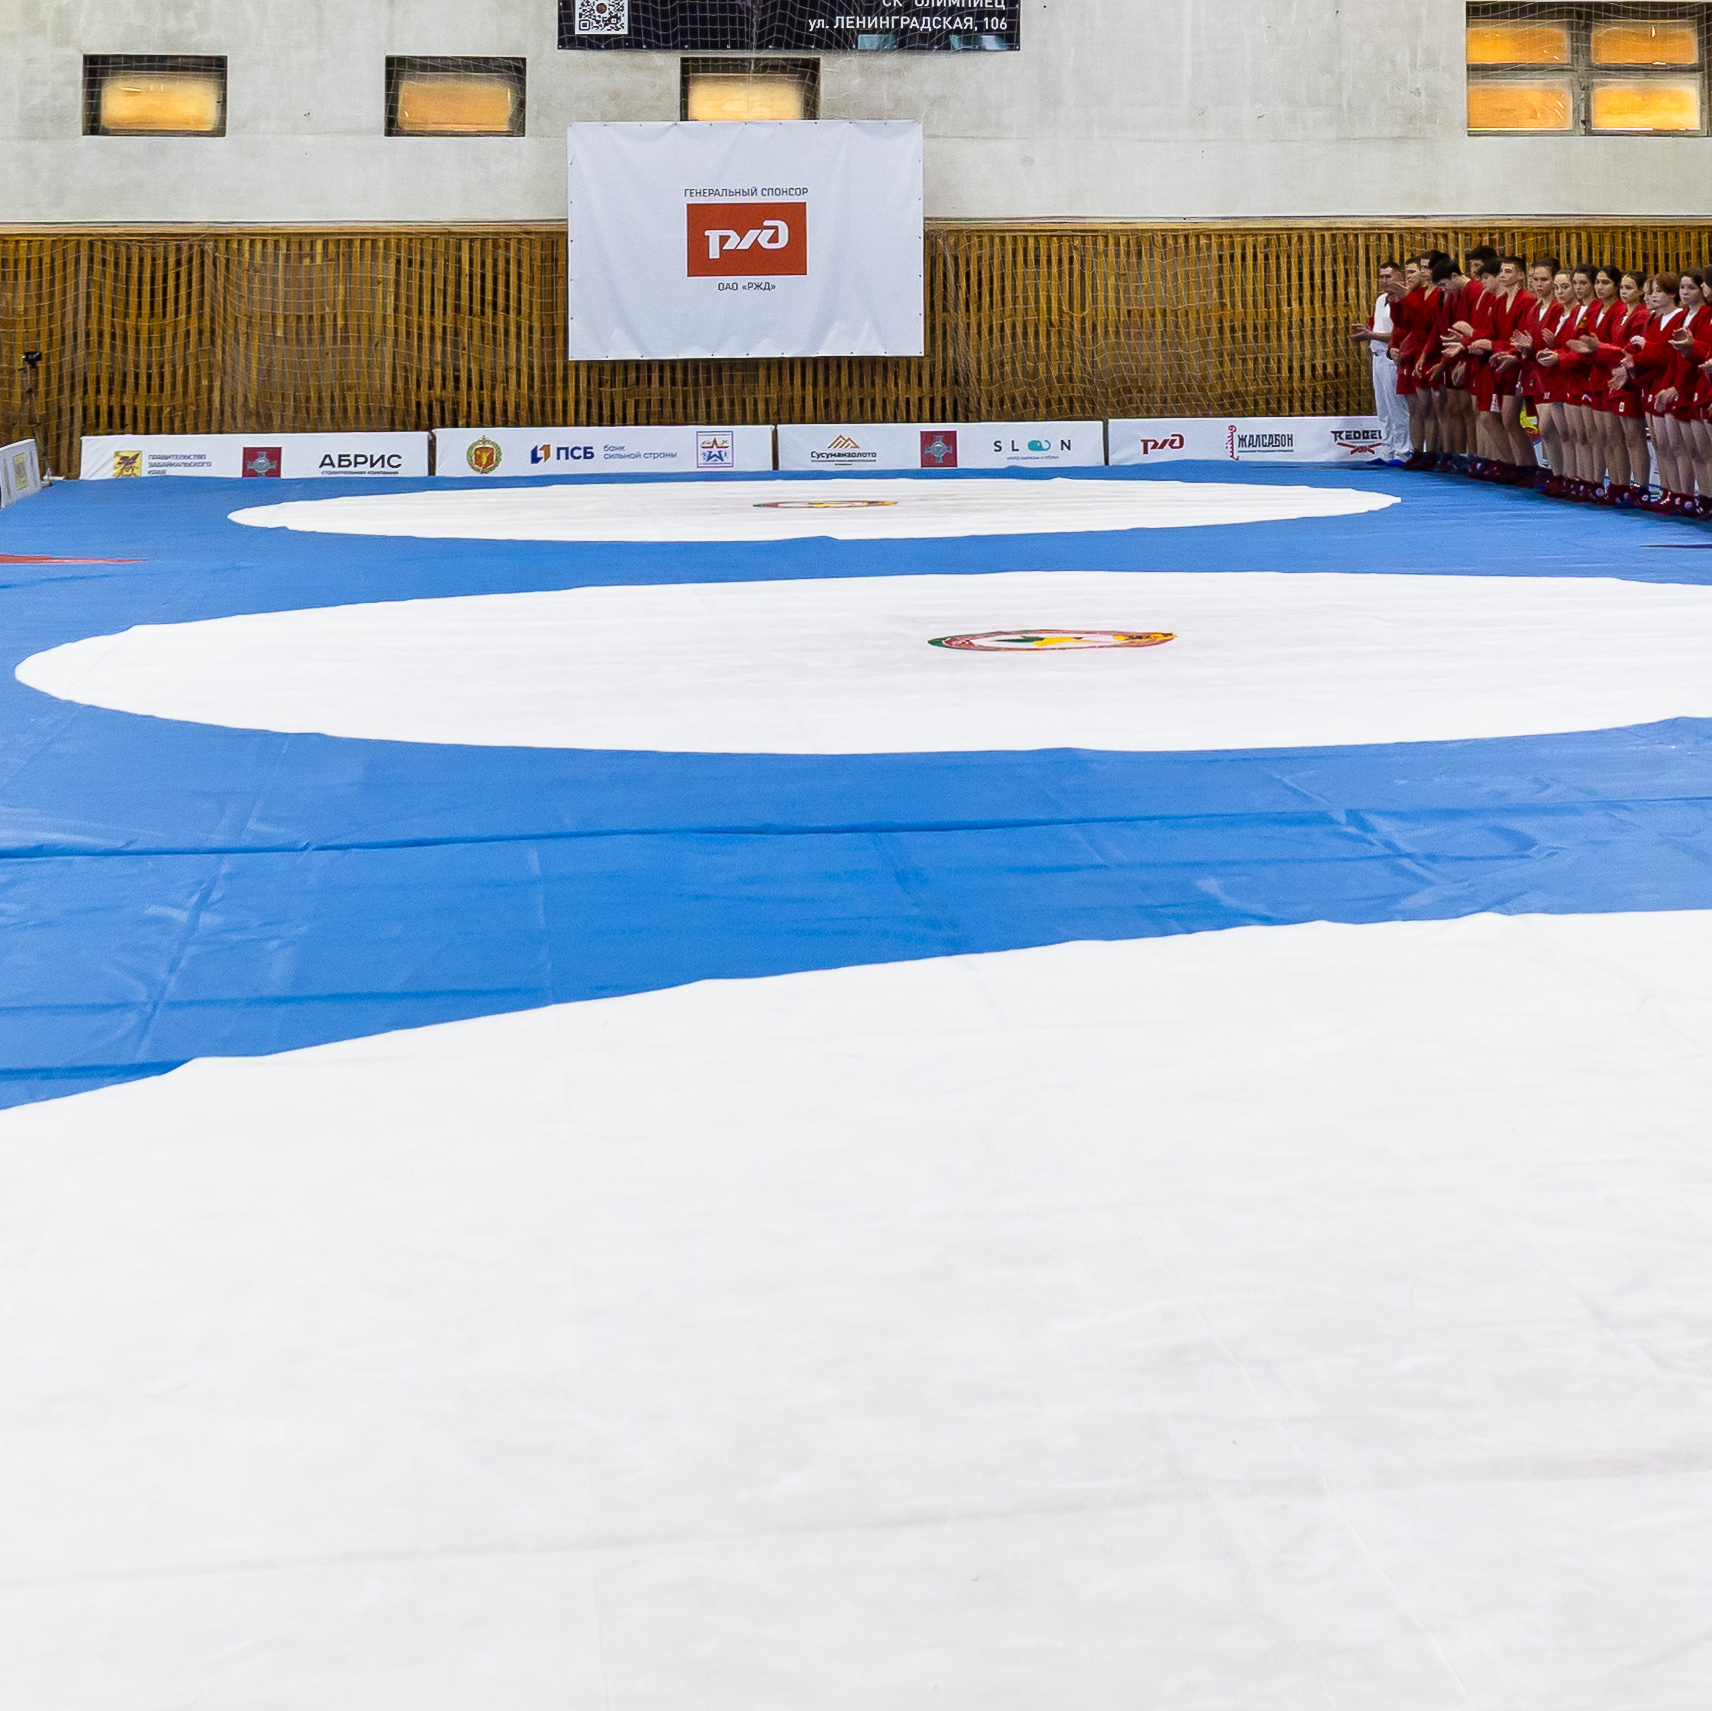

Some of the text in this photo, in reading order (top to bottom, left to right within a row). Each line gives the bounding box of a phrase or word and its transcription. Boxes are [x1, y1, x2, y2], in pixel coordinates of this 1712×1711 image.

[809, 16, 1008, 32] ул. ЛЕНИНГРАДСКАЯ, 106
[684, 187, 809, 197] ГЕНЕРАЛЬНЫЙ СПОНСОР
[717, 282, 739, 291] ОАО
[1237, 434, 1294, 448] ЖАЛСАБОН
[556, 446, 595, 460] ПСБ
[603, 444, 626, 452] банк
[318, 453, 402, 469] АБРИС
[603, 451, 678, 460] сильной страны
